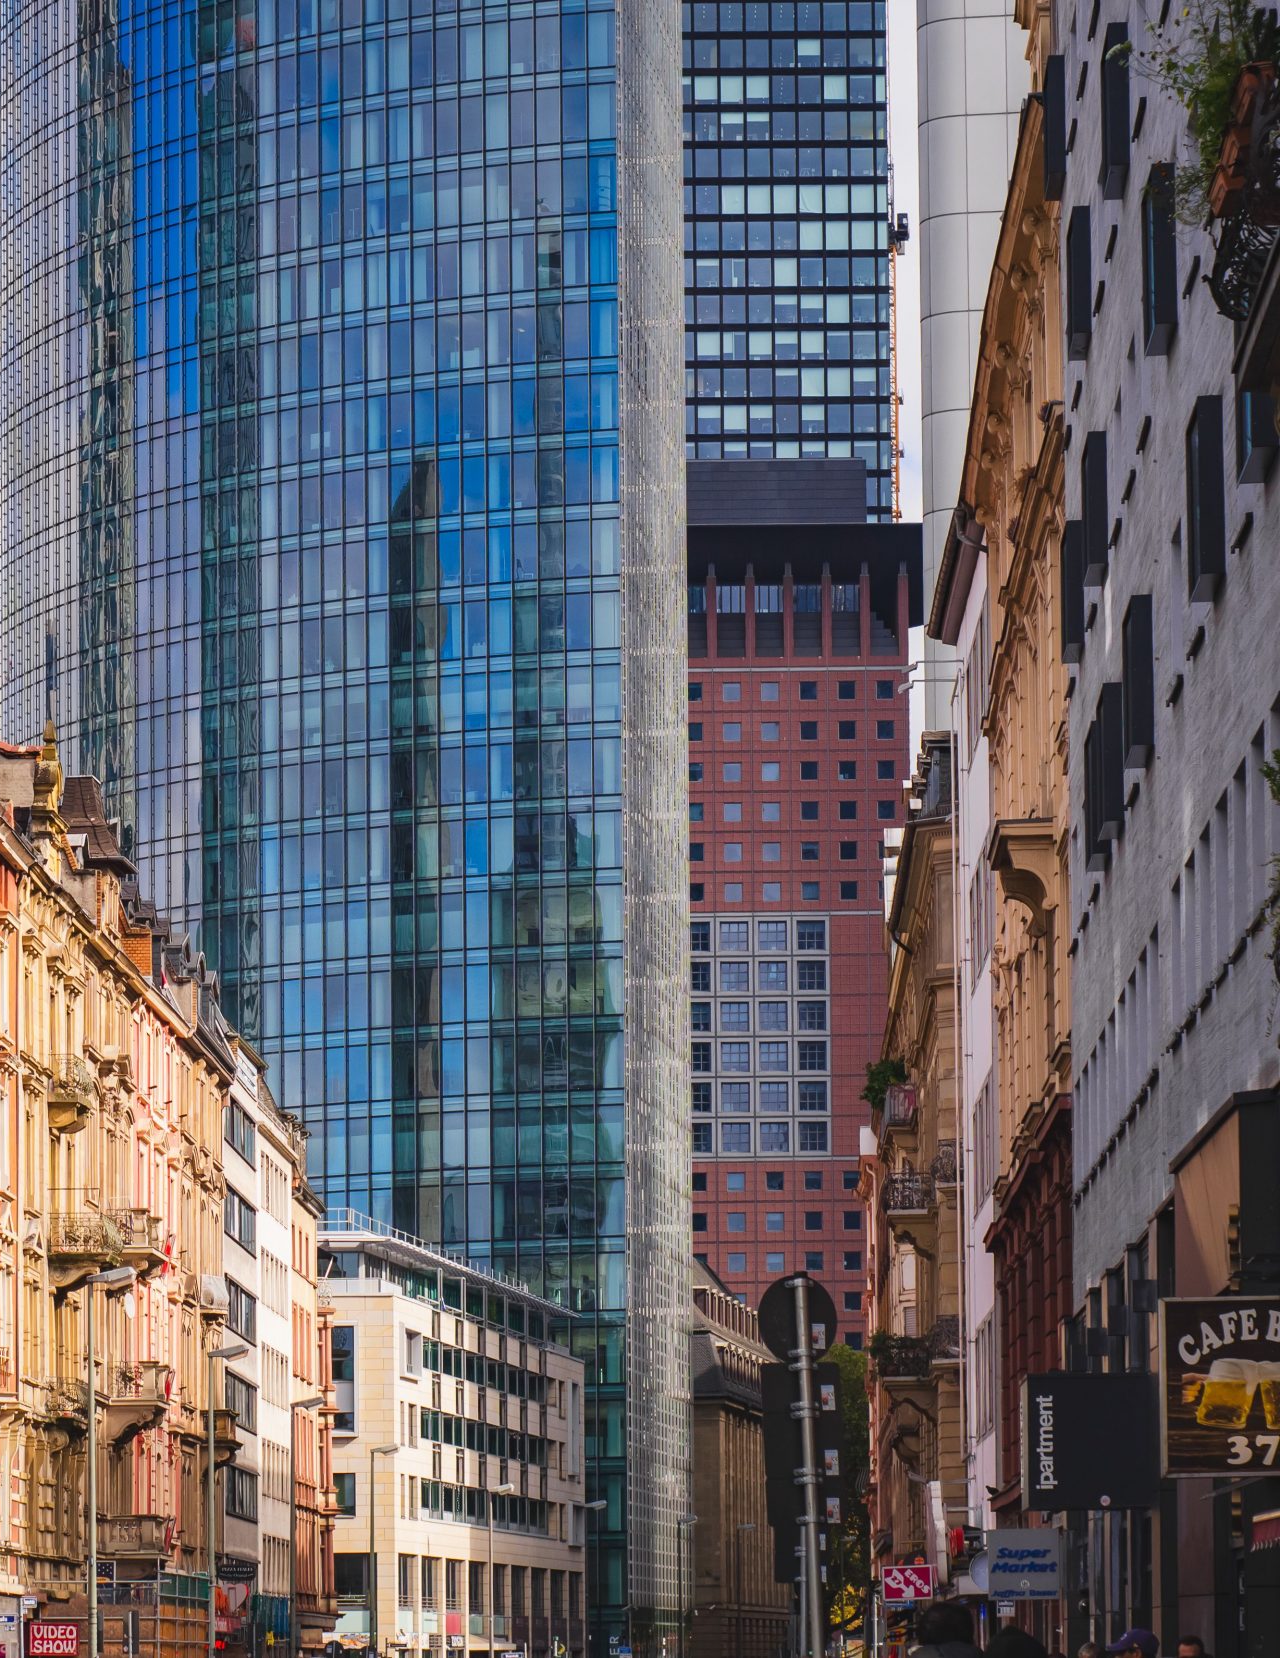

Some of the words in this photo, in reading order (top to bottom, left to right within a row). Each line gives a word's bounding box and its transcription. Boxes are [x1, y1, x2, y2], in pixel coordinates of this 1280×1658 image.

[1178, 1308, 1260, 1366] CAFE
[1036, 1394, 1058, 1490] ipartment
[997, 1547, 1052, 1561] Super
[991, 1561, 1058, 1573] Market
[905, 1568, 931, 1594] EROS
[33, 1625, 77, 1639] VIDEO
[33, 1640, 77, 1653] SHOW
